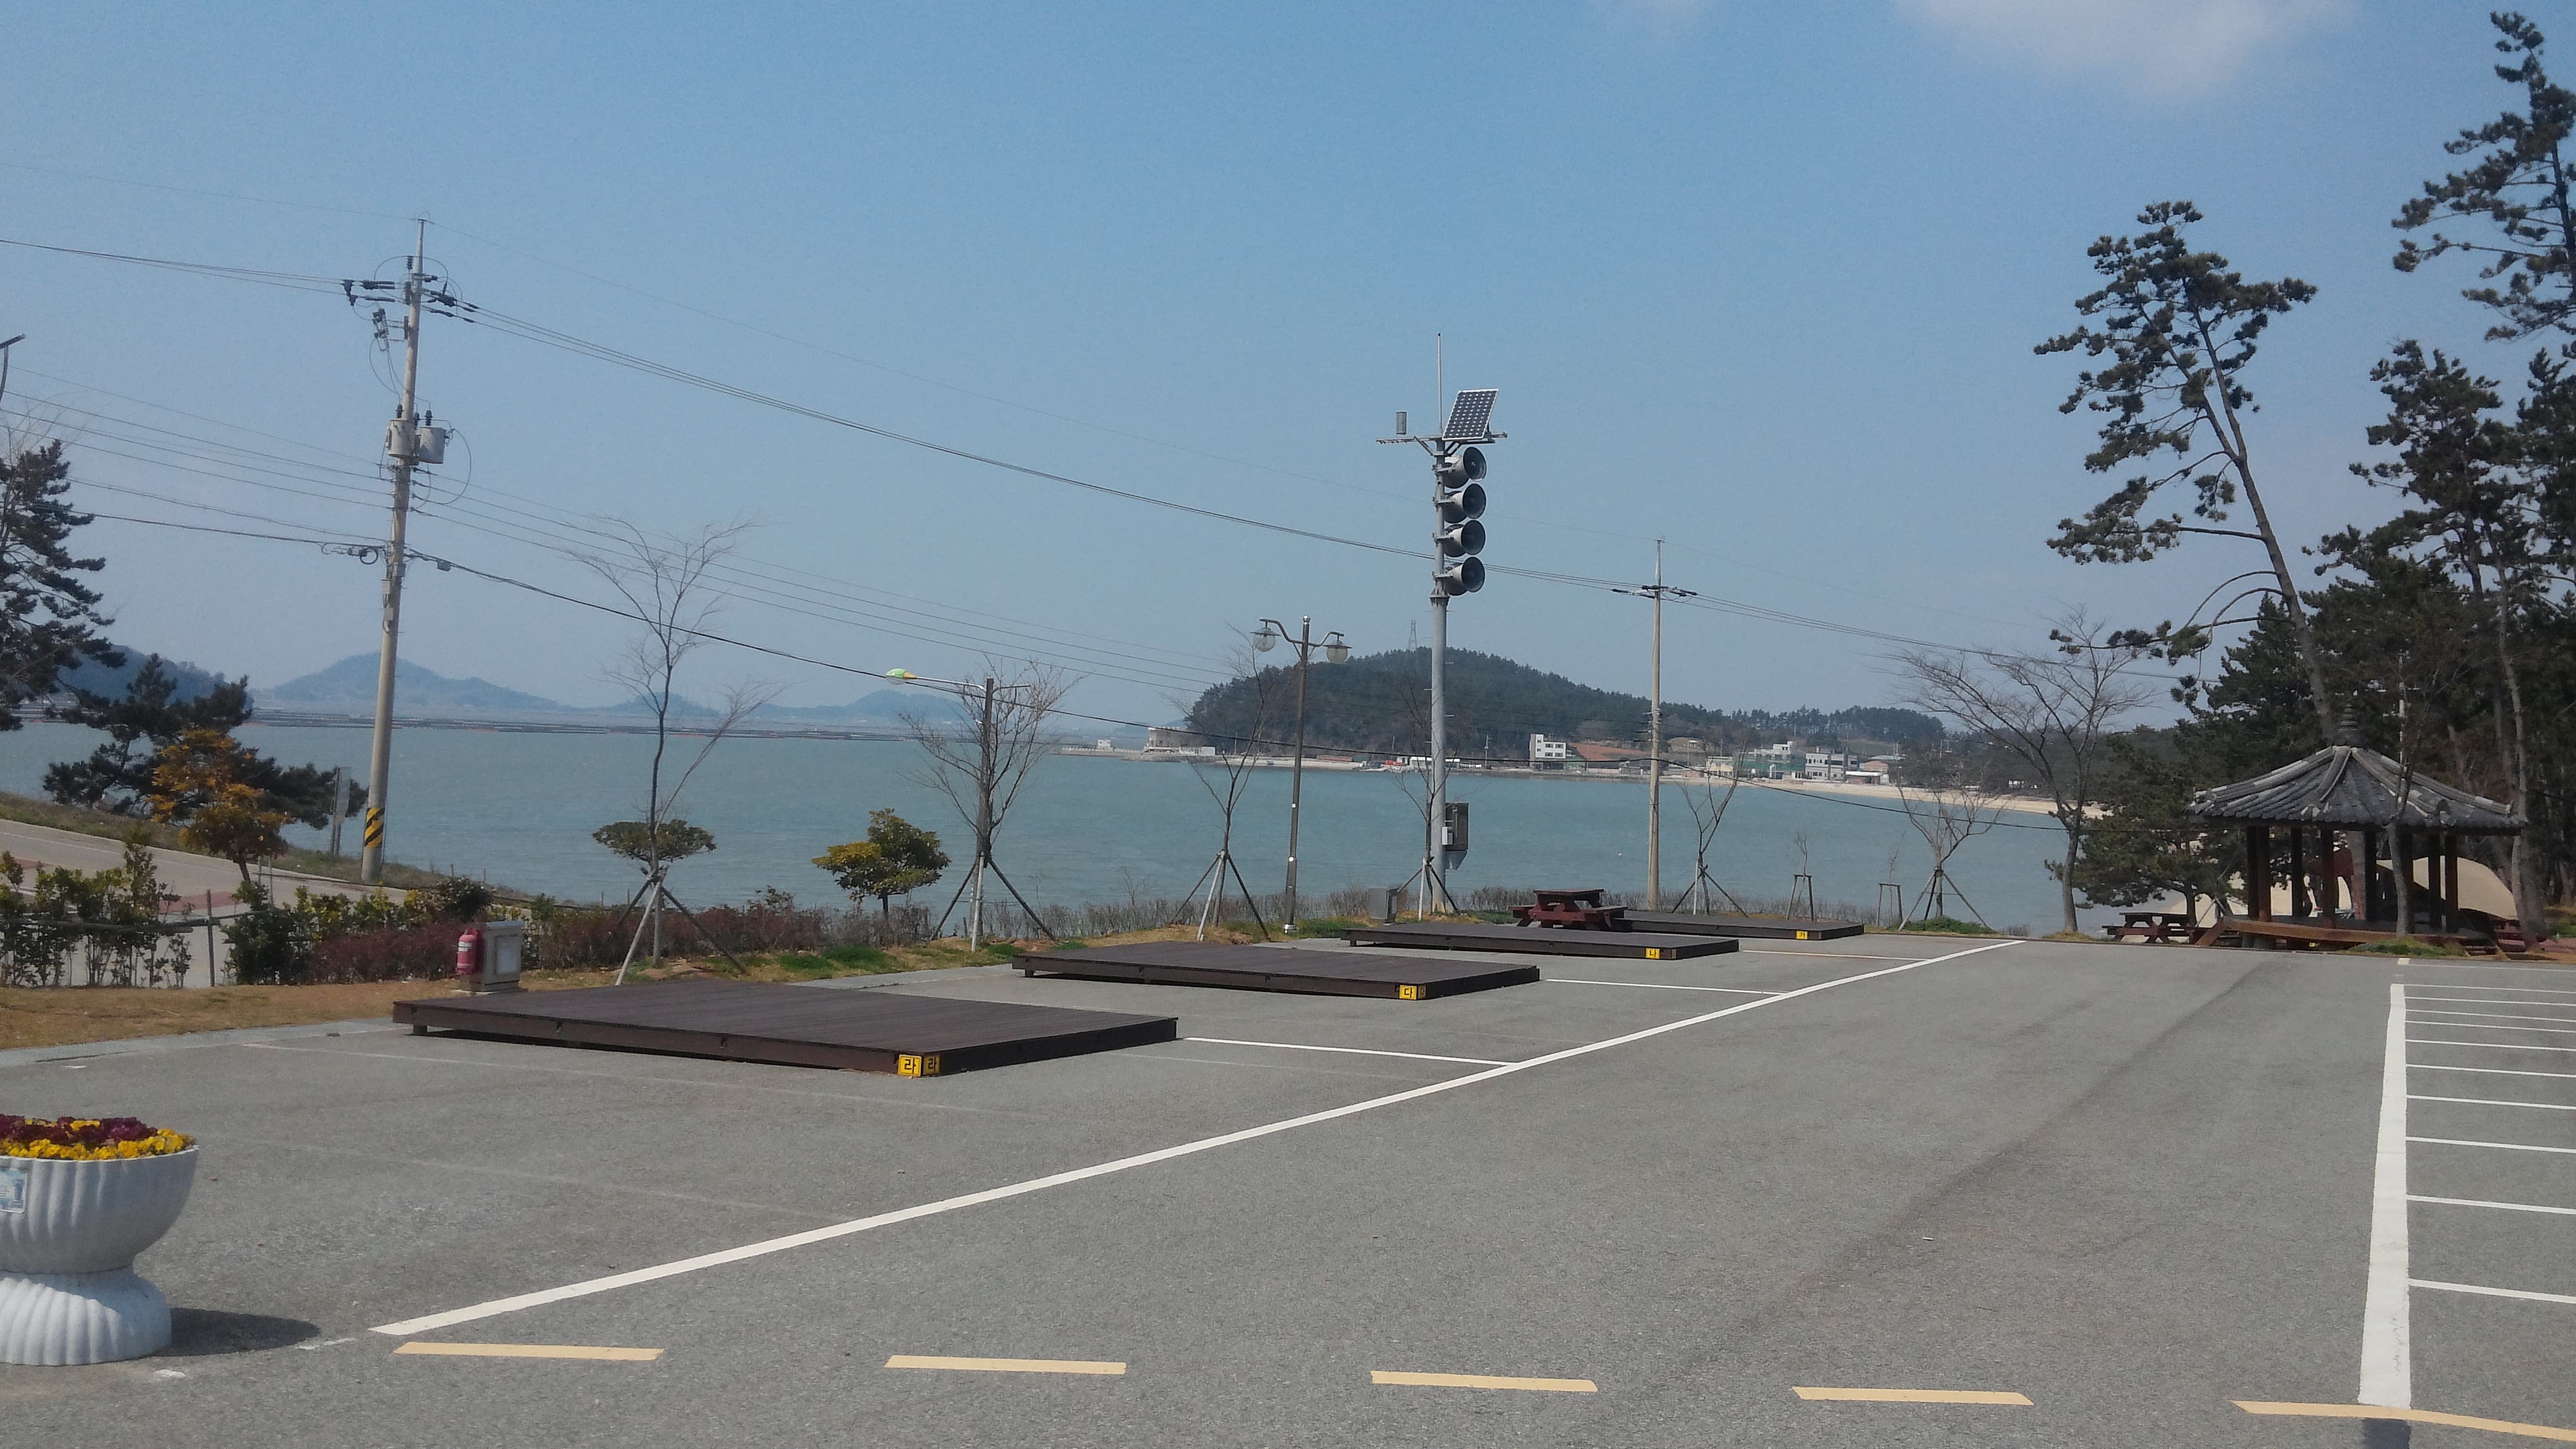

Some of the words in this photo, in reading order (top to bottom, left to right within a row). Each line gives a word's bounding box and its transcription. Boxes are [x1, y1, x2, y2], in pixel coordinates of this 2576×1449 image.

[1404, 986, 1413, 998] 다
[904, 1057, 916, 1074] 라
[928, 1056, 937, 1072] 라
